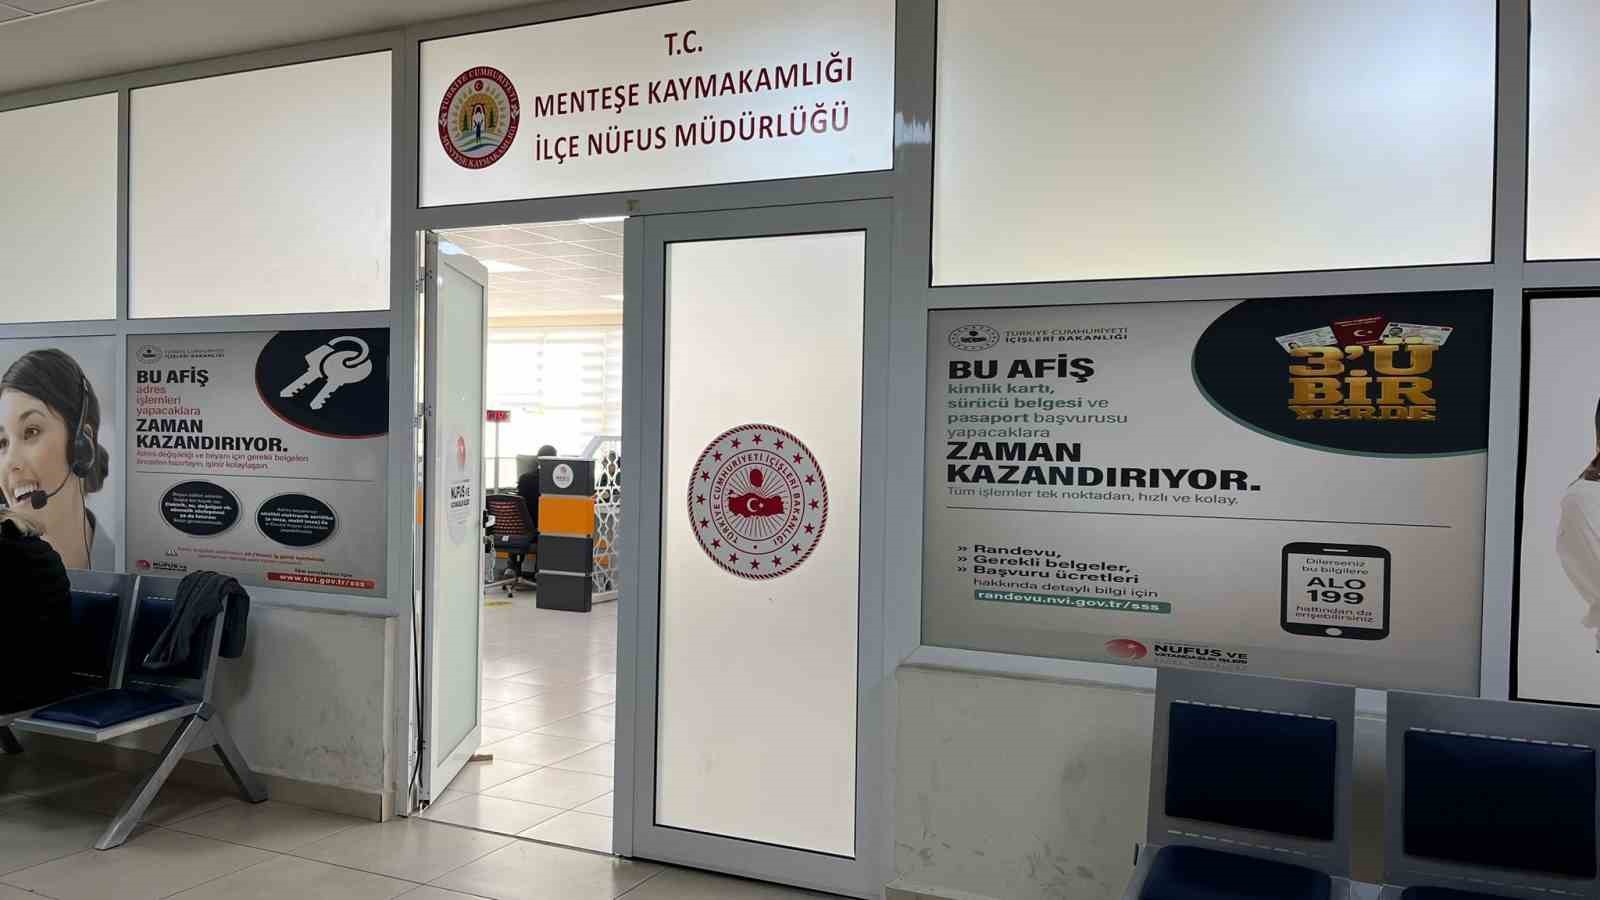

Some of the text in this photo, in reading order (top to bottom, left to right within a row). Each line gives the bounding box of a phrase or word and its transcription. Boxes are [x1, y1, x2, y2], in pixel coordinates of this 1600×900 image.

[664, 31, 703, 56] T.C.
[535, 52, 852, 118] MENTEŞE KAYMAKAMLIĞI
[536, 100, 849, 164] İLÇE NÜFUS MÜDÜRLÜĞÜ
[137, 366, 209, 387] BU AFİŞ
[949, 354, 1095, 383] BU AFİŞ
[949, 383, 1055, 395] kimlik kartı,
[1288, 369, 1437, 405] BİR
[948, 397, 1109, 411] sürücü belgesi ve
[136, 418, 203, 433] ZAMAN
[948, 412, 1129, 425] pasaport başvurusu
[947, 427, 1051, 439] yapacaklara
[137, 434, 288, 452] KAZANDIRIYOR.
[947, 442, 1081, 462] ZAMAN
[947, 464, 1261, 491] KAZANDIRIYOR.
[948, 487, 975, 497] Tüm
[979, 488, 1032, 501] işlemler
[1036, 489, 1058, 499] tek
[1062, 490, 1135, 504] noktadan,
[1139, 492, 1167, 503] hızlı
[1195, 496, 1239, 507] kolay.
[974, 545, 1061, 558] Randevu,
[974, 556, 1130, 573] Gerekli belgeler,
[974, 566, 1140, 584] Başvuru ücretleri
[1307, 577, 1366, 590] ALO
[974, 578, 1158, 600] hakkında detaylı bilgi için
[1306, 590, 1364, 605] 199
[977, 591, 1160, 611] randevu.nvi.gov.tr/sss
